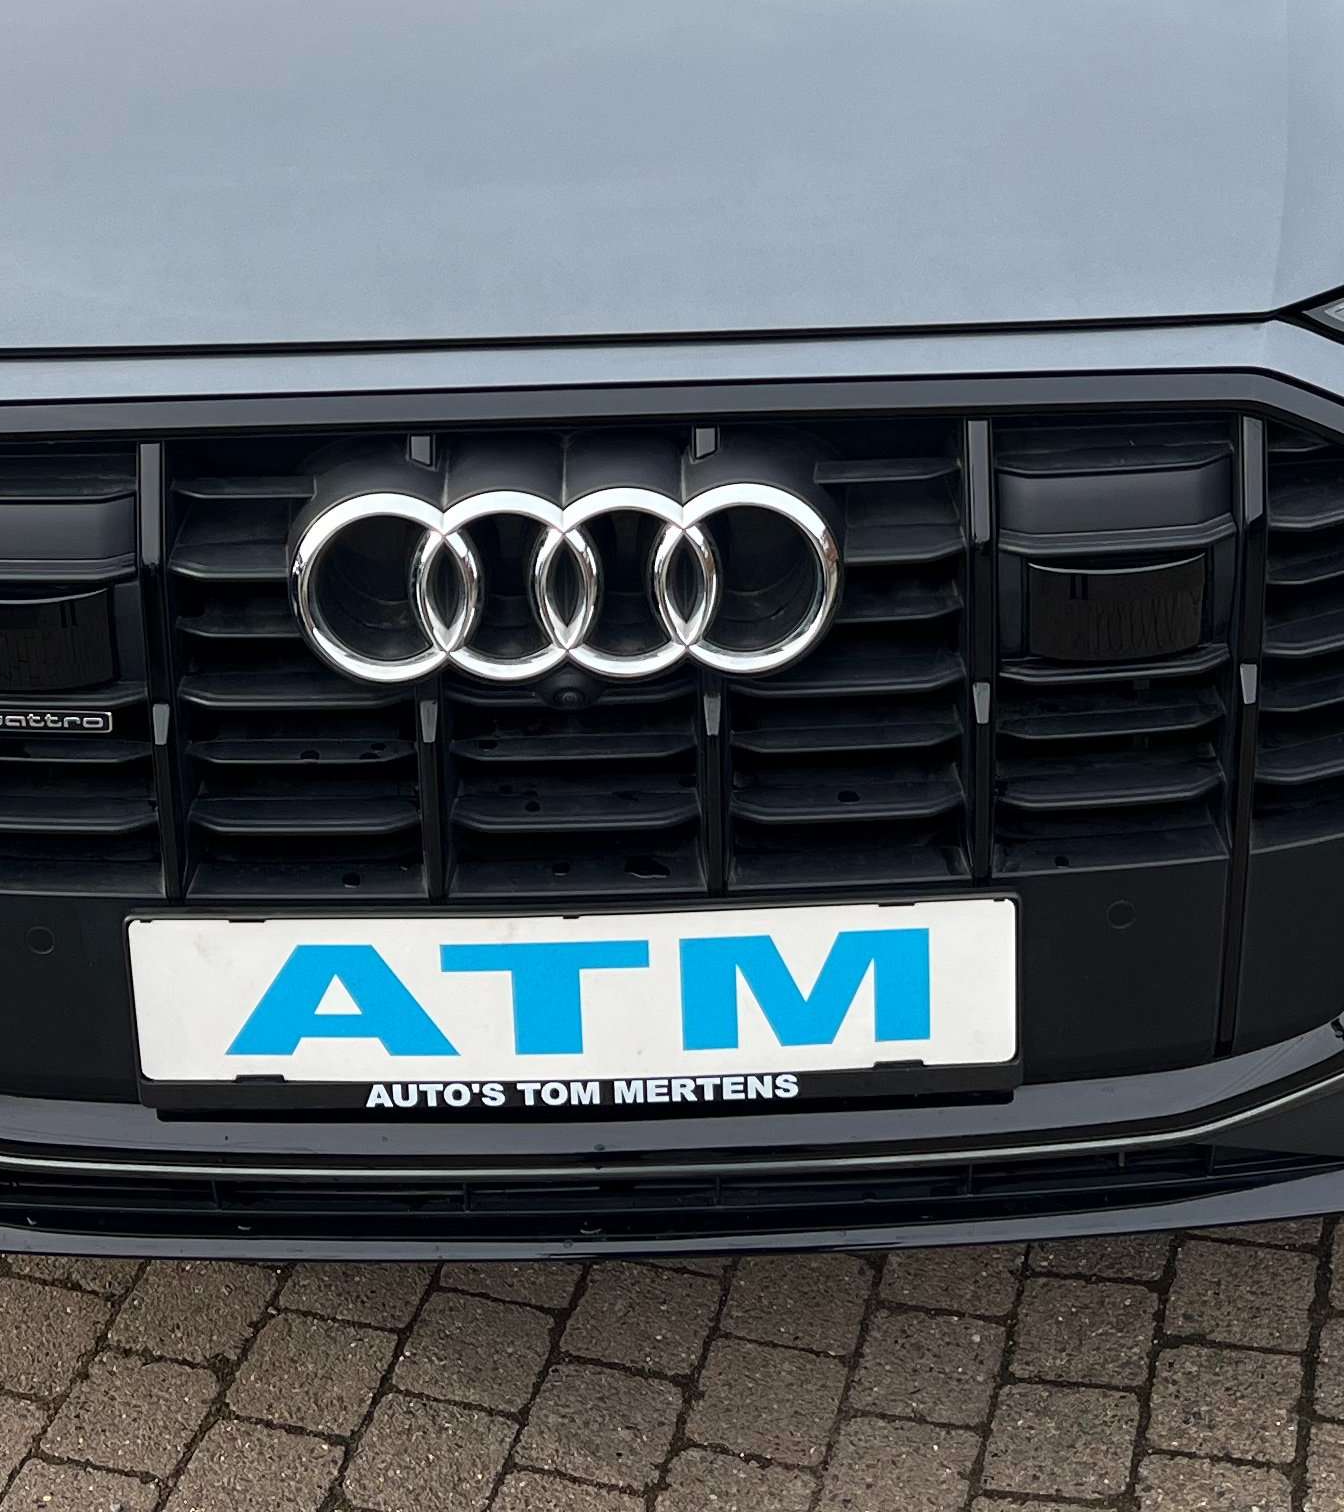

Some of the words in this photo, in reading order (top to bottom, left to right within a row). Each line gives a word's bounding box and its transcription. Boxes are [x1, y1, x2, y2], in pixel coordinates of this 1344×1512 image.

[225, 928, 931, 1056] ATM
[365, 1083, 506, 1108] AUTO'S
[516, 1081, 601, 1105] TOM
[613, 1075, 799, 1104] MERTENS
